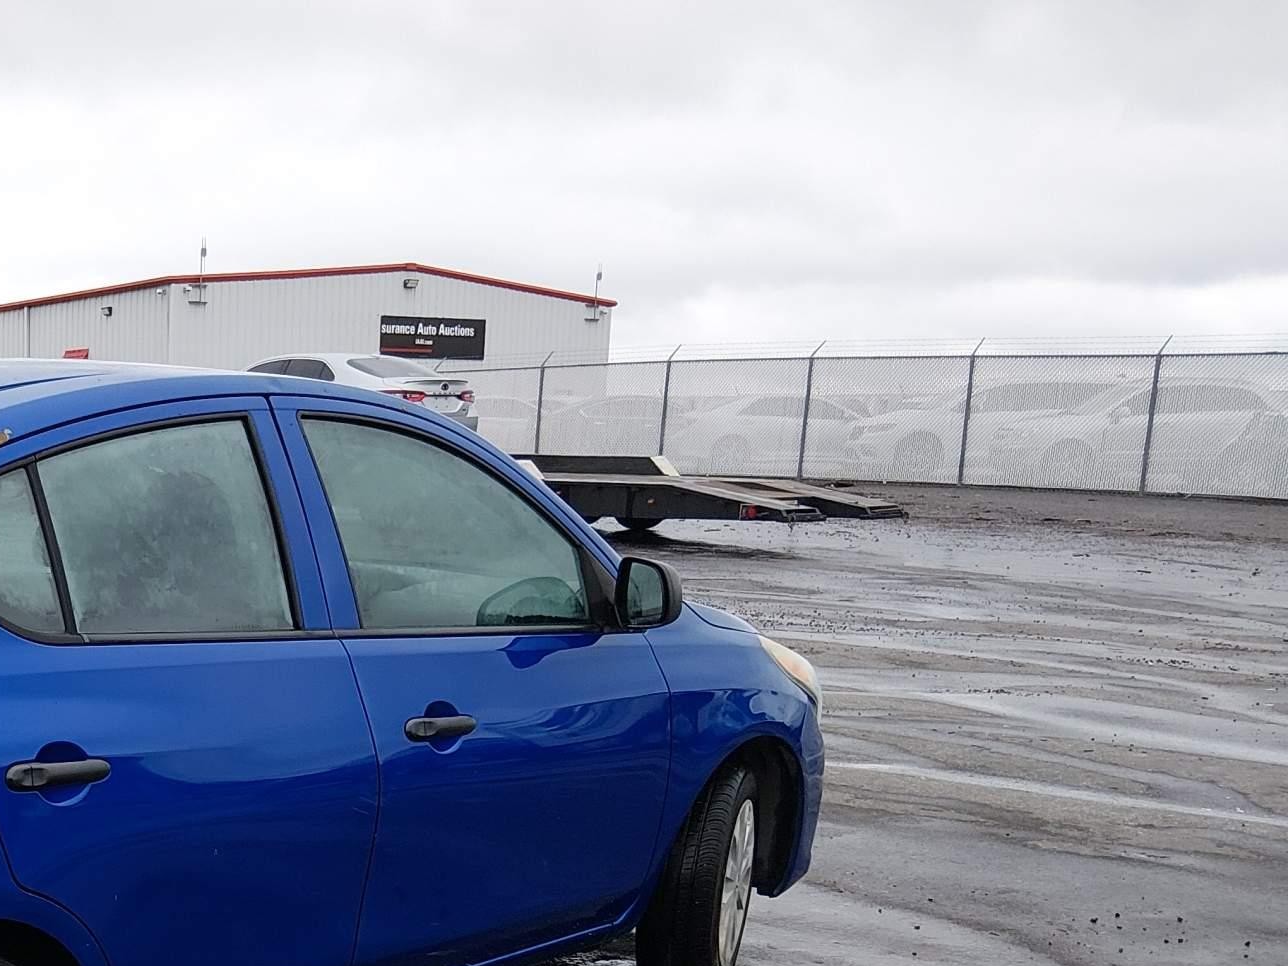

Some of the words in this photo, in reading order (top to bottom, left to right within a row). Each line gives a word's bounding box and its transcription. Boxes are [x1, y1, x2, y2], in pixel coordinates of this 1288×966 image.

[381, 324, 415, 335] surance
[417, 323, 437, 335] Auto
[438, 324, 474, 337] Auctions
